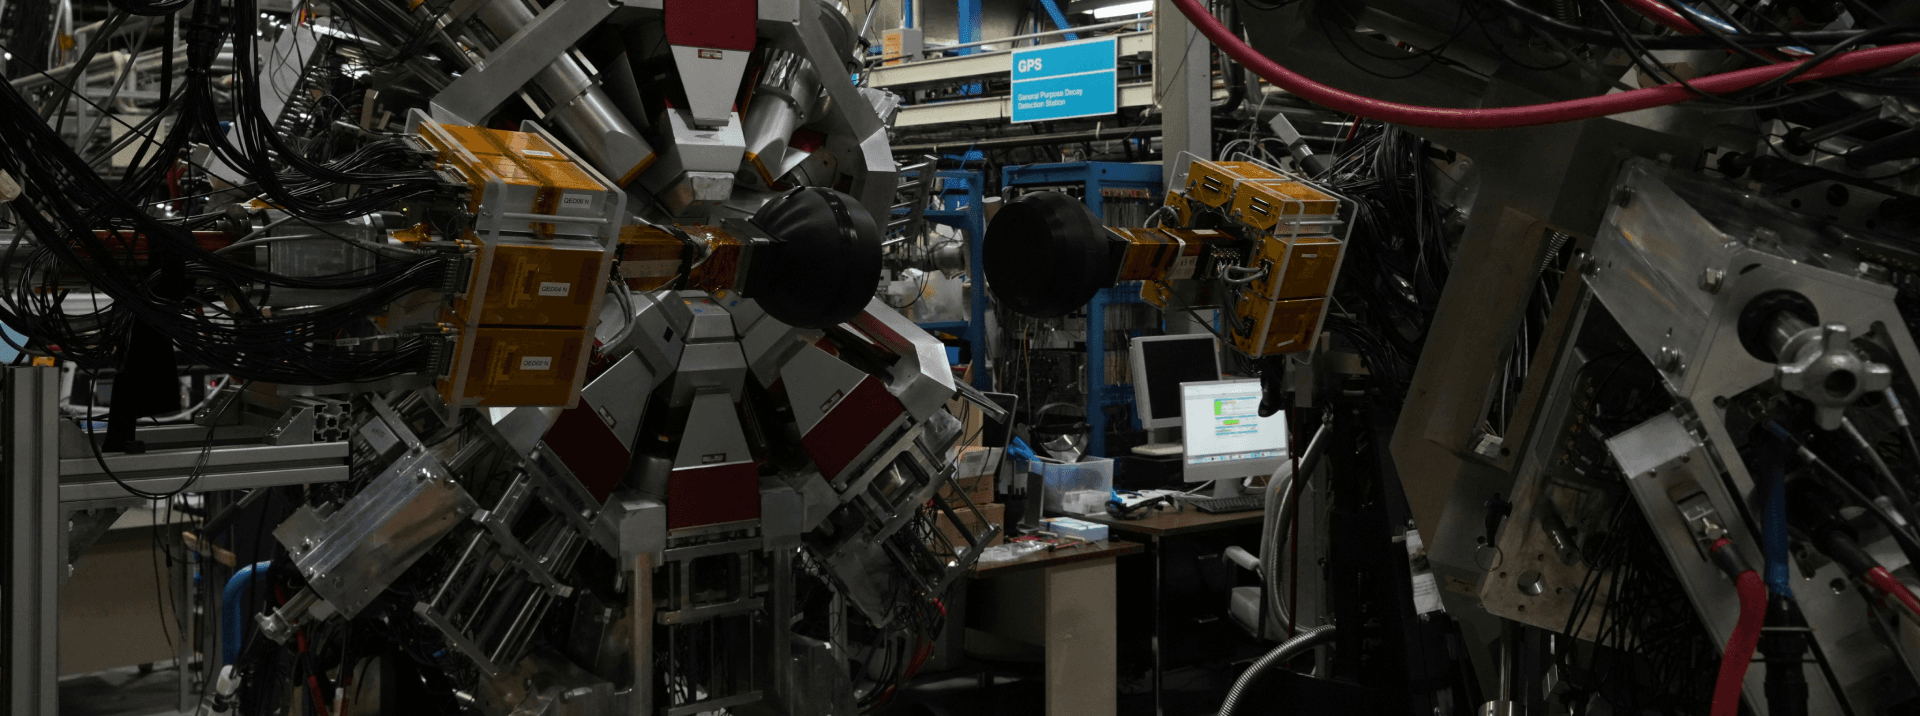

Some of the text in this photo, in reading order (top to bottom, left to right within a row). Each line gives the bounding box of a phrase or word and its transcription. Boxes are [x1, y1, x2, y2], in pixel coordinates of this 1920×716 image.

[1018, 57, 1043, 73] GPS
[1018, 88, 1083, 101] General Purpose Decay
[1018, 99, 1066, 110] Detection Station
